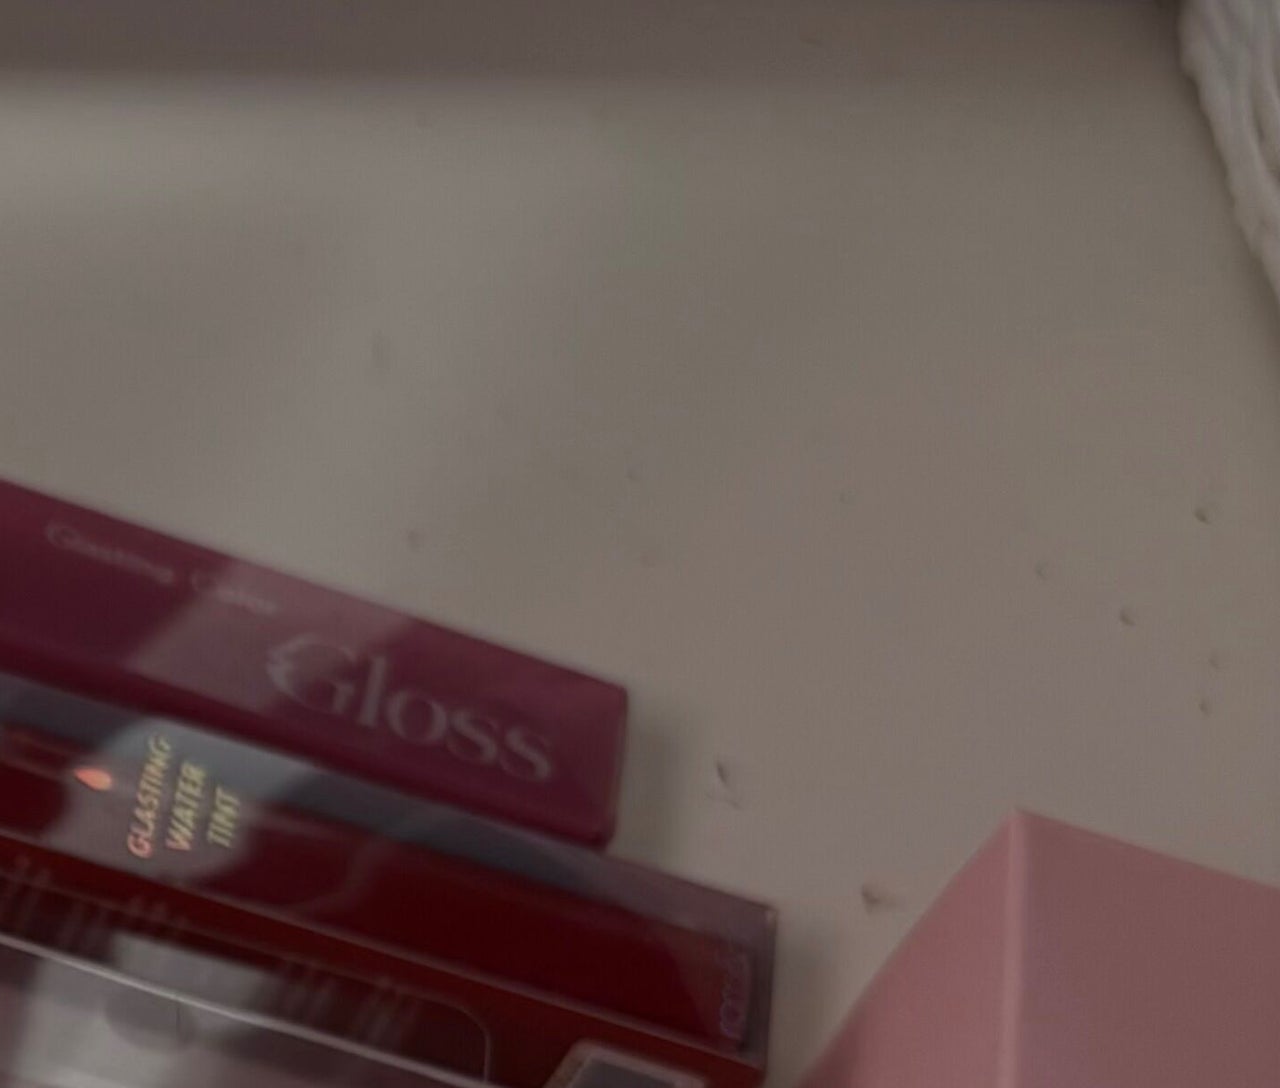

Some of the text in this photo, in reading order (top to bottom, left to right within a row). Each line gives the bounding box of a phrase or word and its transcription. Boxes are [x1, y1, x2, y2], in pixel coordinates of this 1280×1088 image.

[266, 634, 554, 786] Gloss
[127, 733, 172, 859] GLASTING
[164, 761, 208, 851] WATER
[206, 785, 241, 849] TINT
